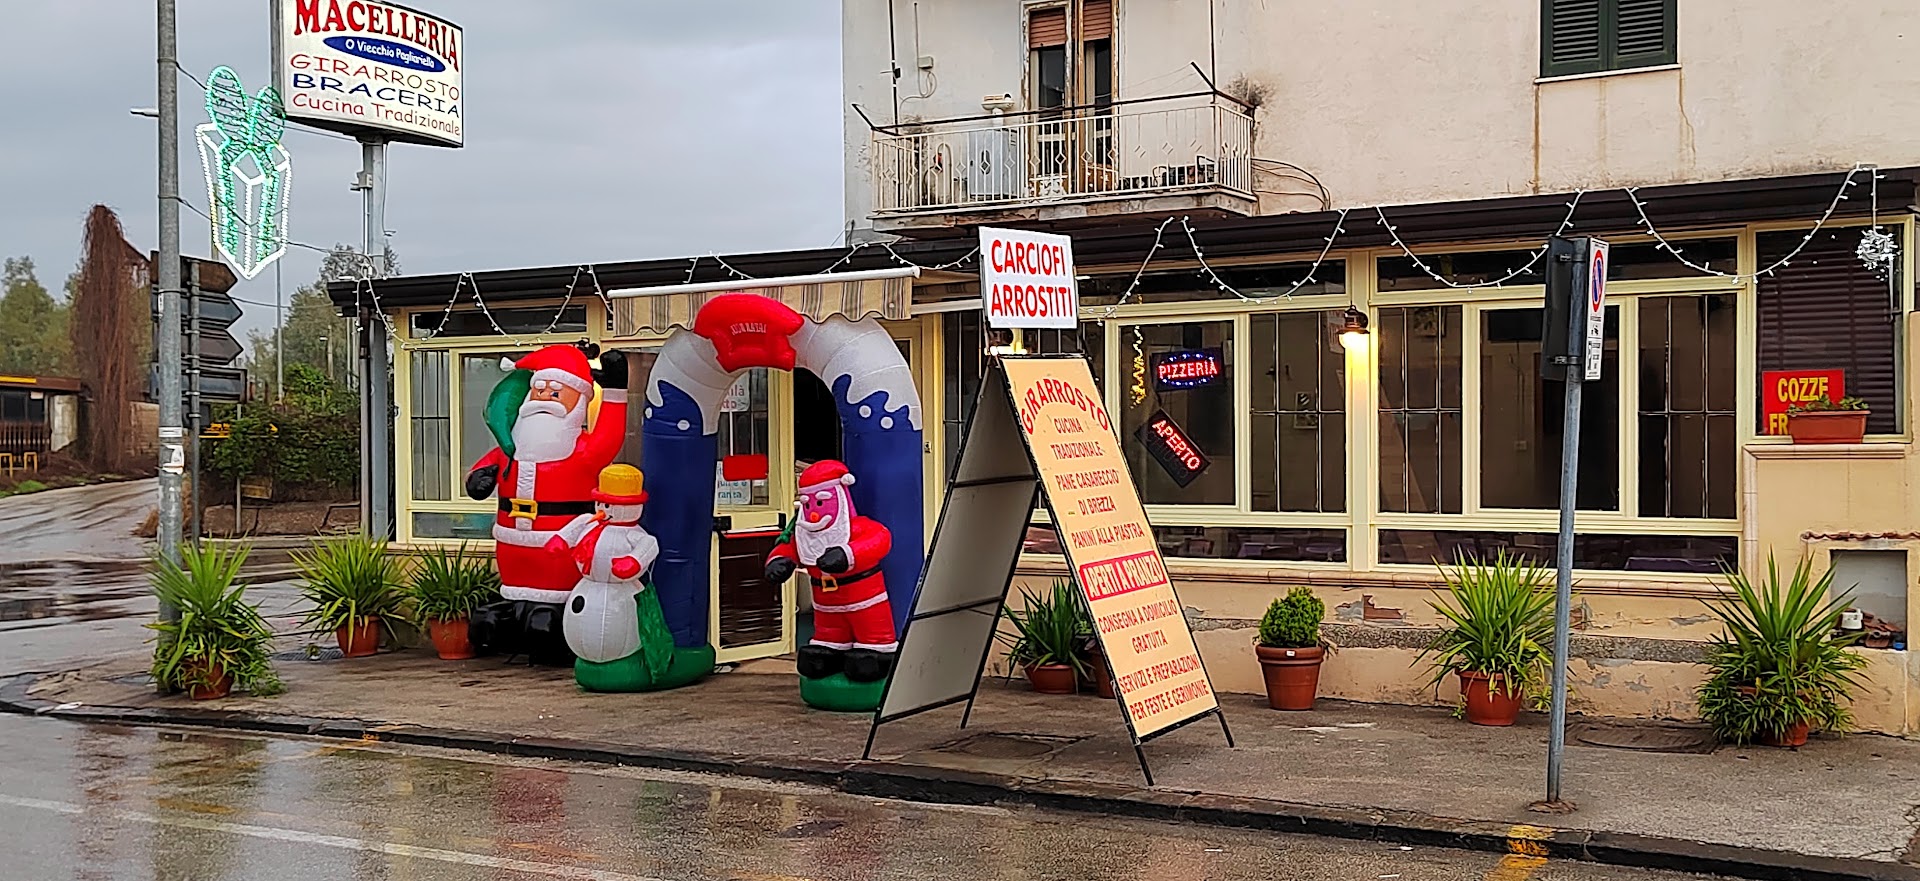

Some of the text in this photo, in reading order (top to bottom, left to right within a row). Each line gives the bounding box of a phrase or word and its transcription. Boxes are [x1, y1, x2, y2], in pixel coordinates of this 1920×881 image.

[294, 0, 459, 72] MACELLERIA
[345, 38, 355, 50] O
[290, 54, 460, 101] GIRARROSTO
[293, 74, 459, 118] BRACERIA
[293, 93, 460, 136] Cucina Tradizionale
[991, 239, 1066, 276] CARCIOFI
[991, 283, 1073, 317] ARROSTITI
[1158, 361, 1218, 379] PIZZERIA
[1021, 378, 1109, 435] GIRARROSTO
[1777, 377, 1829, 402] COZZE
[1053, 417, 1084, 434] CUCINA
[1050, 441, 1104, 460] TRADIZIONALE
[1151, 419, 1201, 471] APERTO
[1055, 468, 1120, 491] PANE CASARECCIO
[1078, 499, 1090, 515] DI
[1071, 521, 1145, 549] PANINI ALLA PIASTRA
[1083, 554, 1164, 598] APERTI A PRANZO
[1098, 599, 1178, 634] CONSEGNA A DOMICILIO
[1131, 629, 1169, 655] GRATUITA
[1118, 653, 1201, 695] SERVIZI E PREPARAZIONI
[1129, 678, 1209, 722] PER FESTE E CERIMONIE
